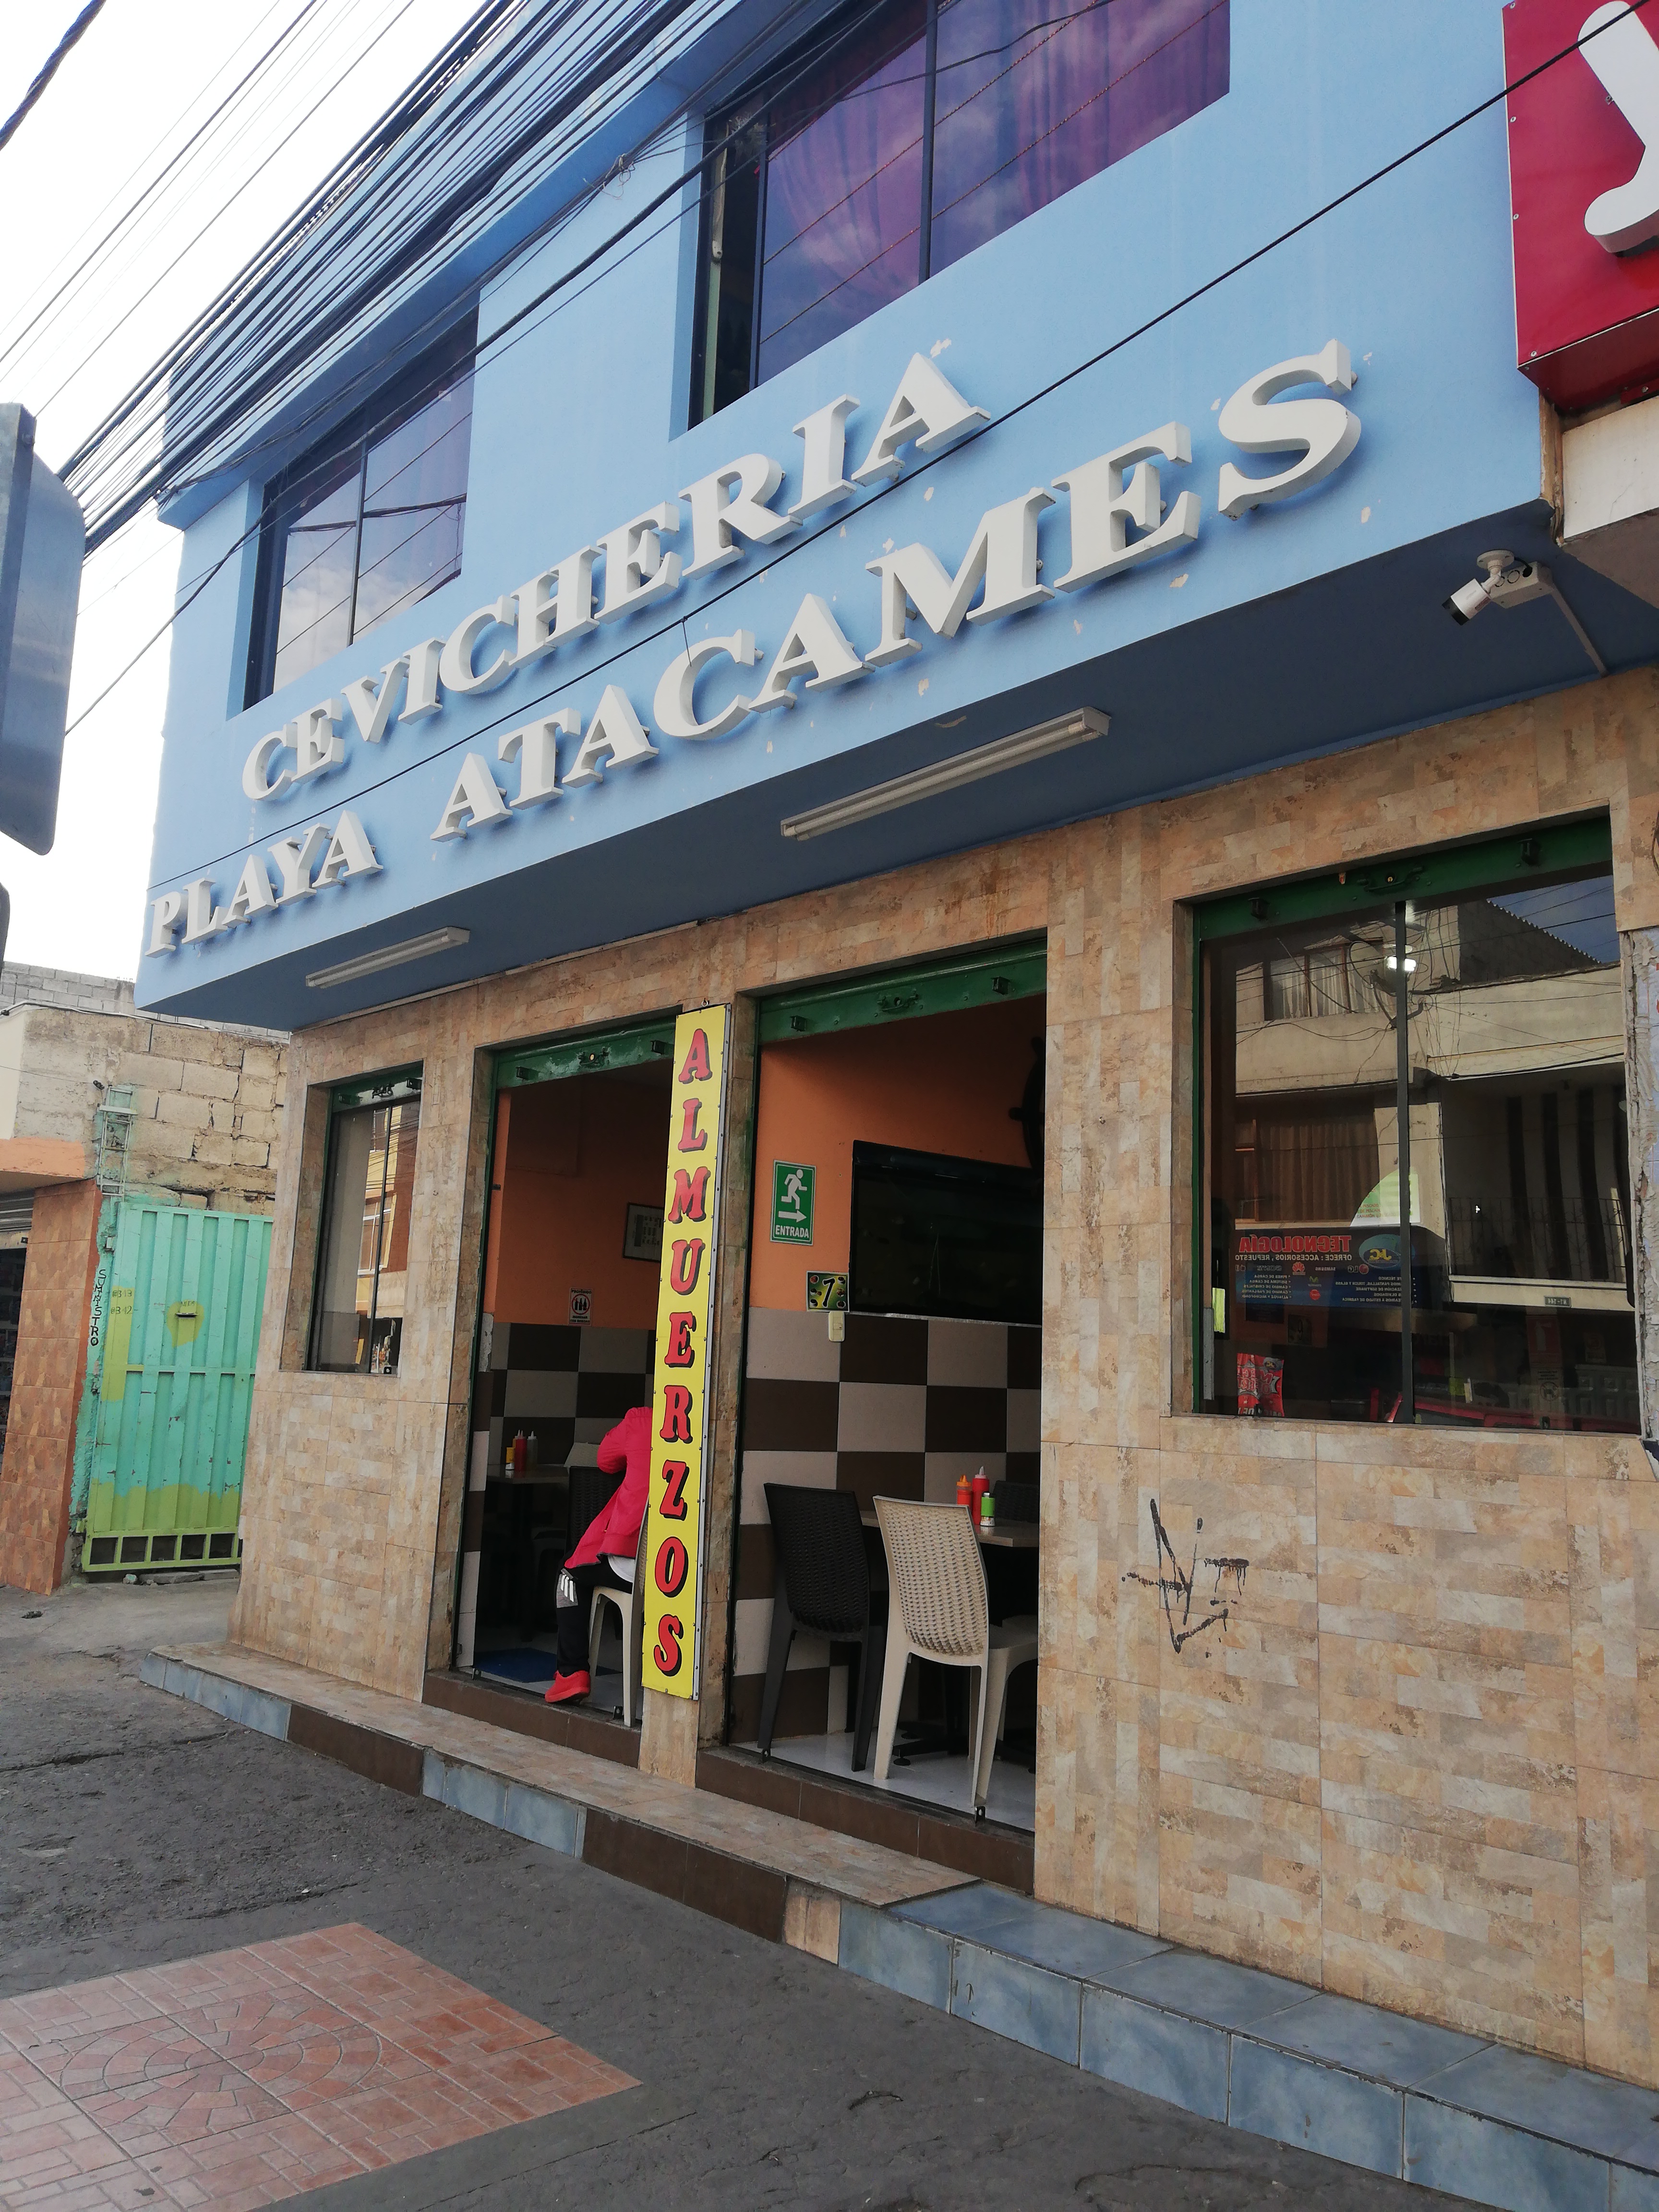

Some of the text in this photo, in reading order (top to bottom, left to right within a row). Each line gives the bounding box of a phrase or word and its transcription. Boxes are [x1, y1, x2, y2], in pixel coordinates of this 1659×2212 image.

[145, 338, 1361, 958] PLAYA ATACAMES
[242, 352, 991, 801] CEVICHERIA
[653, 1028, 713, 1677] ALMUERZOS
[775, 1225, 809, 1238] ENTRADA
